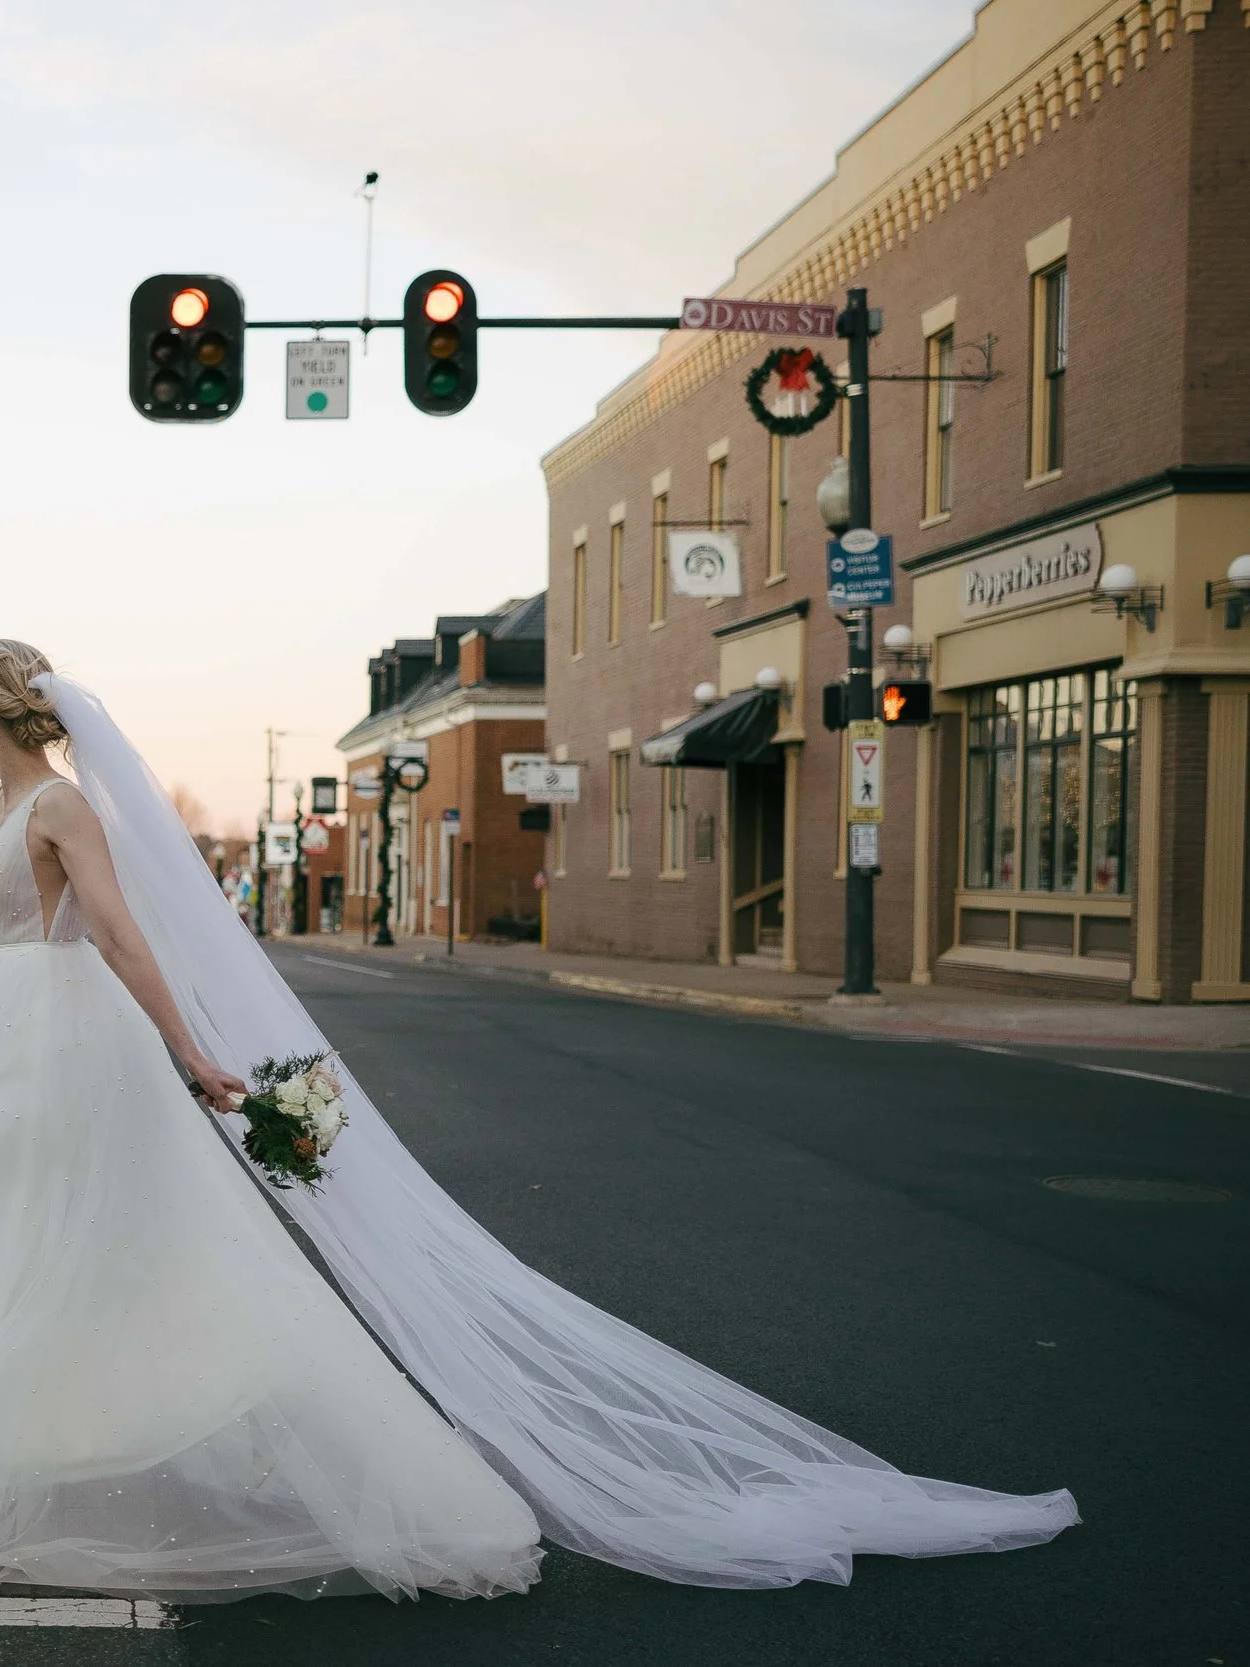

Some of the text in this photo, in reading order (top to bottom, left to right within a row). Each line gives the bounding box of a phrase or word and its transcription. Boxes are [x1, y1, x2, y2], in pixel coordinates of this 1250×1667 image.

[710, 302, 831, 334] DAVIS ST
[302, 361, 336, 374] YIELD
[846, 554, 879, 564] VISITOR
[847, 565, 880, 576] CENTER
[965, 542, 1091, 607] Pepperberries
